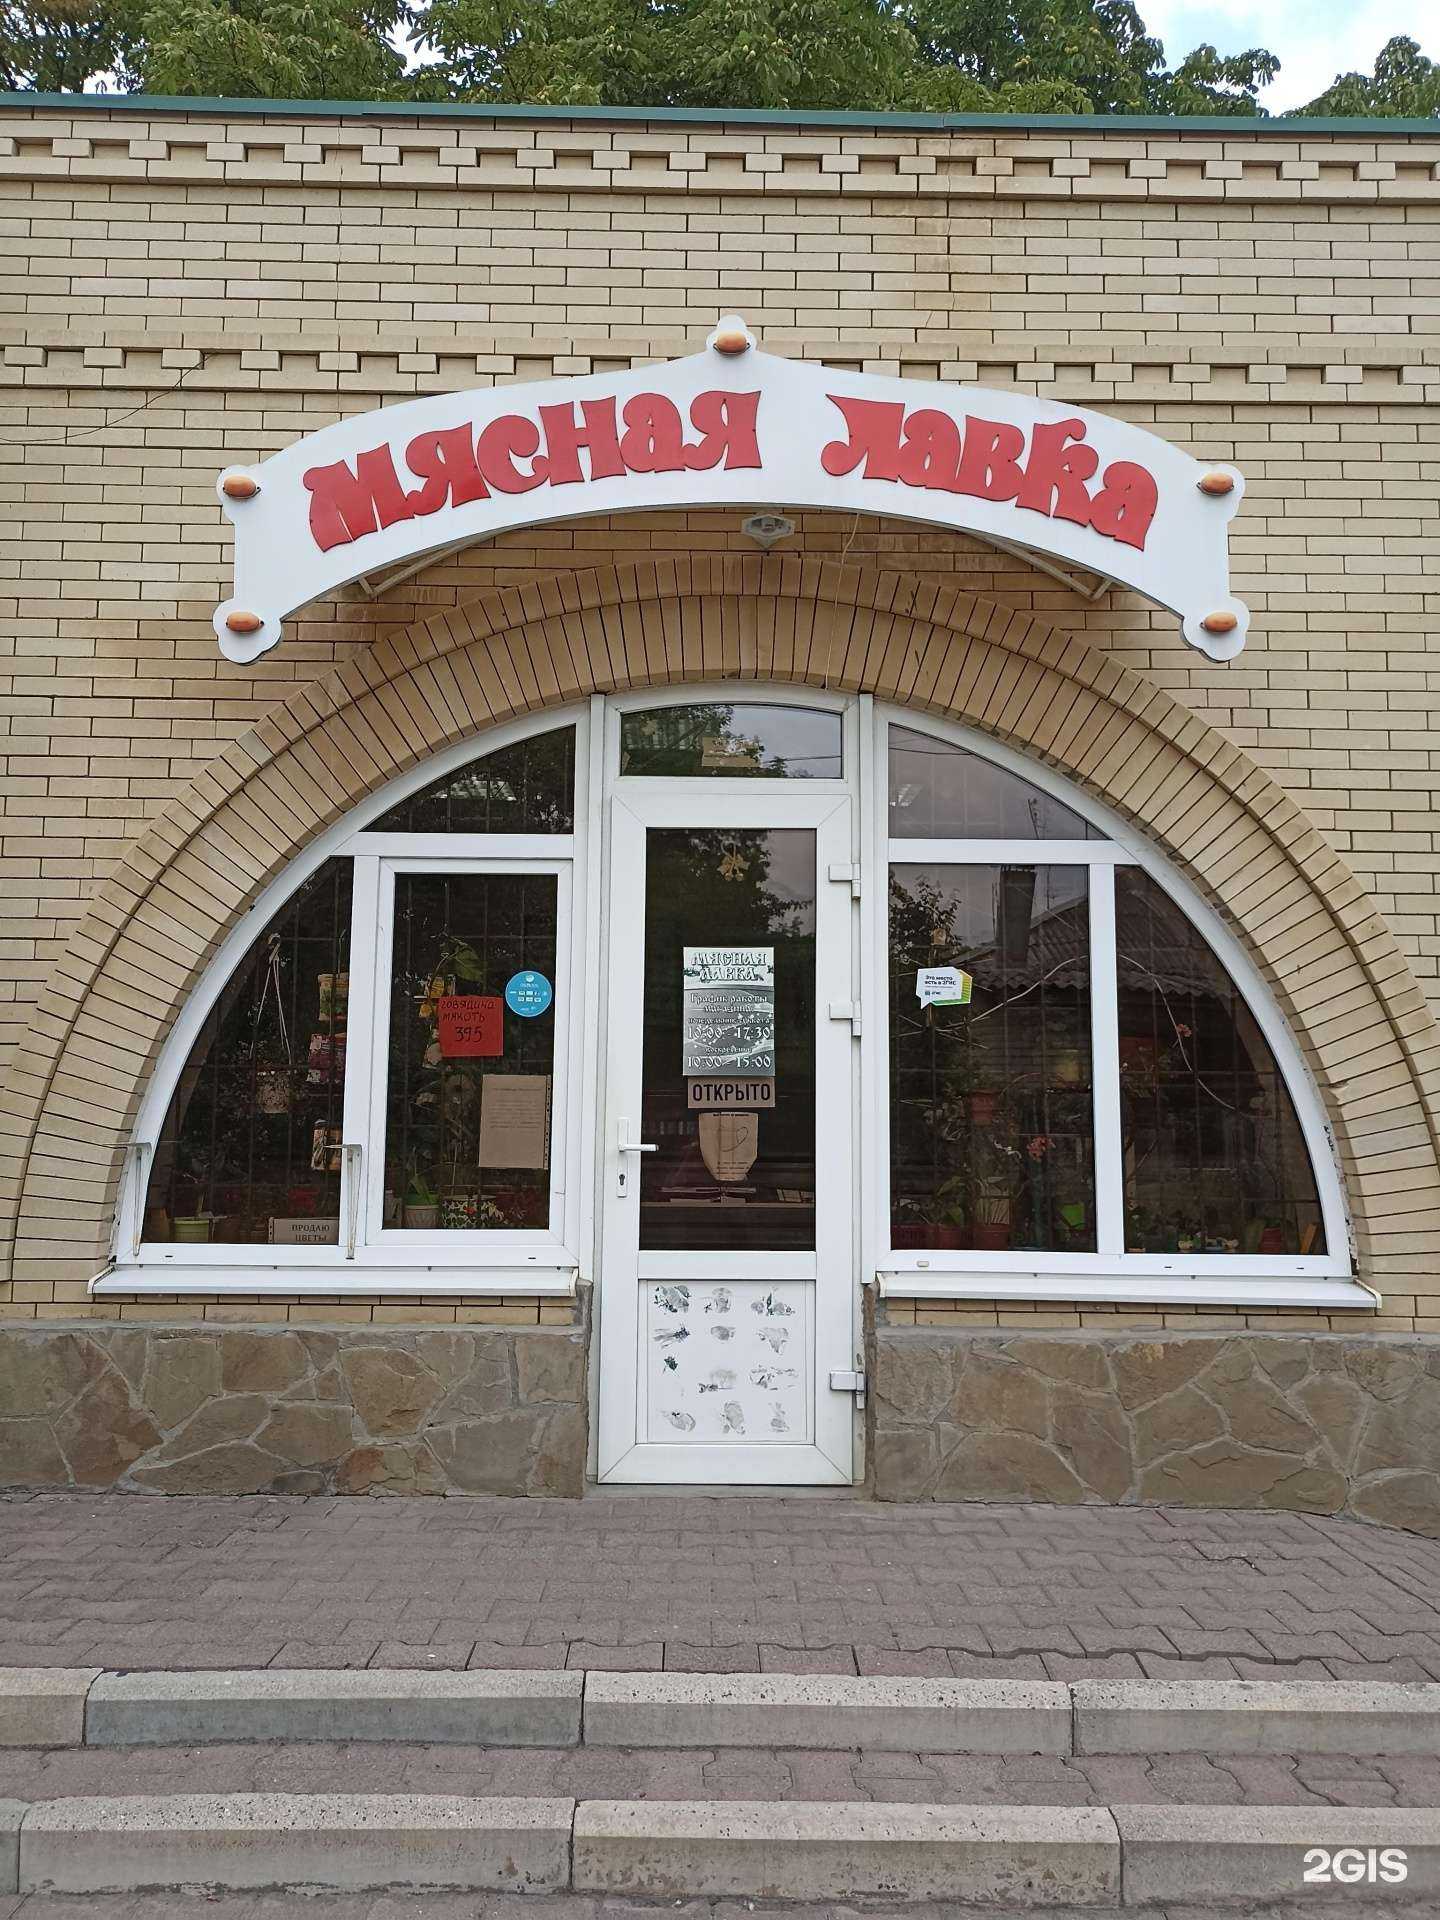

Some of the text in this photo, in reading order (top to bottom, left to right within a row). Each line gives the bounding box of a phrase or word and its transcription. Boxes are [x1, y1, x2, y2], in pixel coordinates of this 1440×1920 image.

[455, 1026, 482, 1043] 395
[687, 1026, 723, 1039] 10:00
[736, 1026, 771, 1039] 17:30
[687, 1055, 723, 1068] 10:00
[736, 1055, 771, 1068] 15:00
[692, 1083, 771, 1102] ОТКРЫТО
[291, 1224, 330, 1232] ПРОДАЮ
[296, 1234, 327, 1242] ЦВЕТЫ
